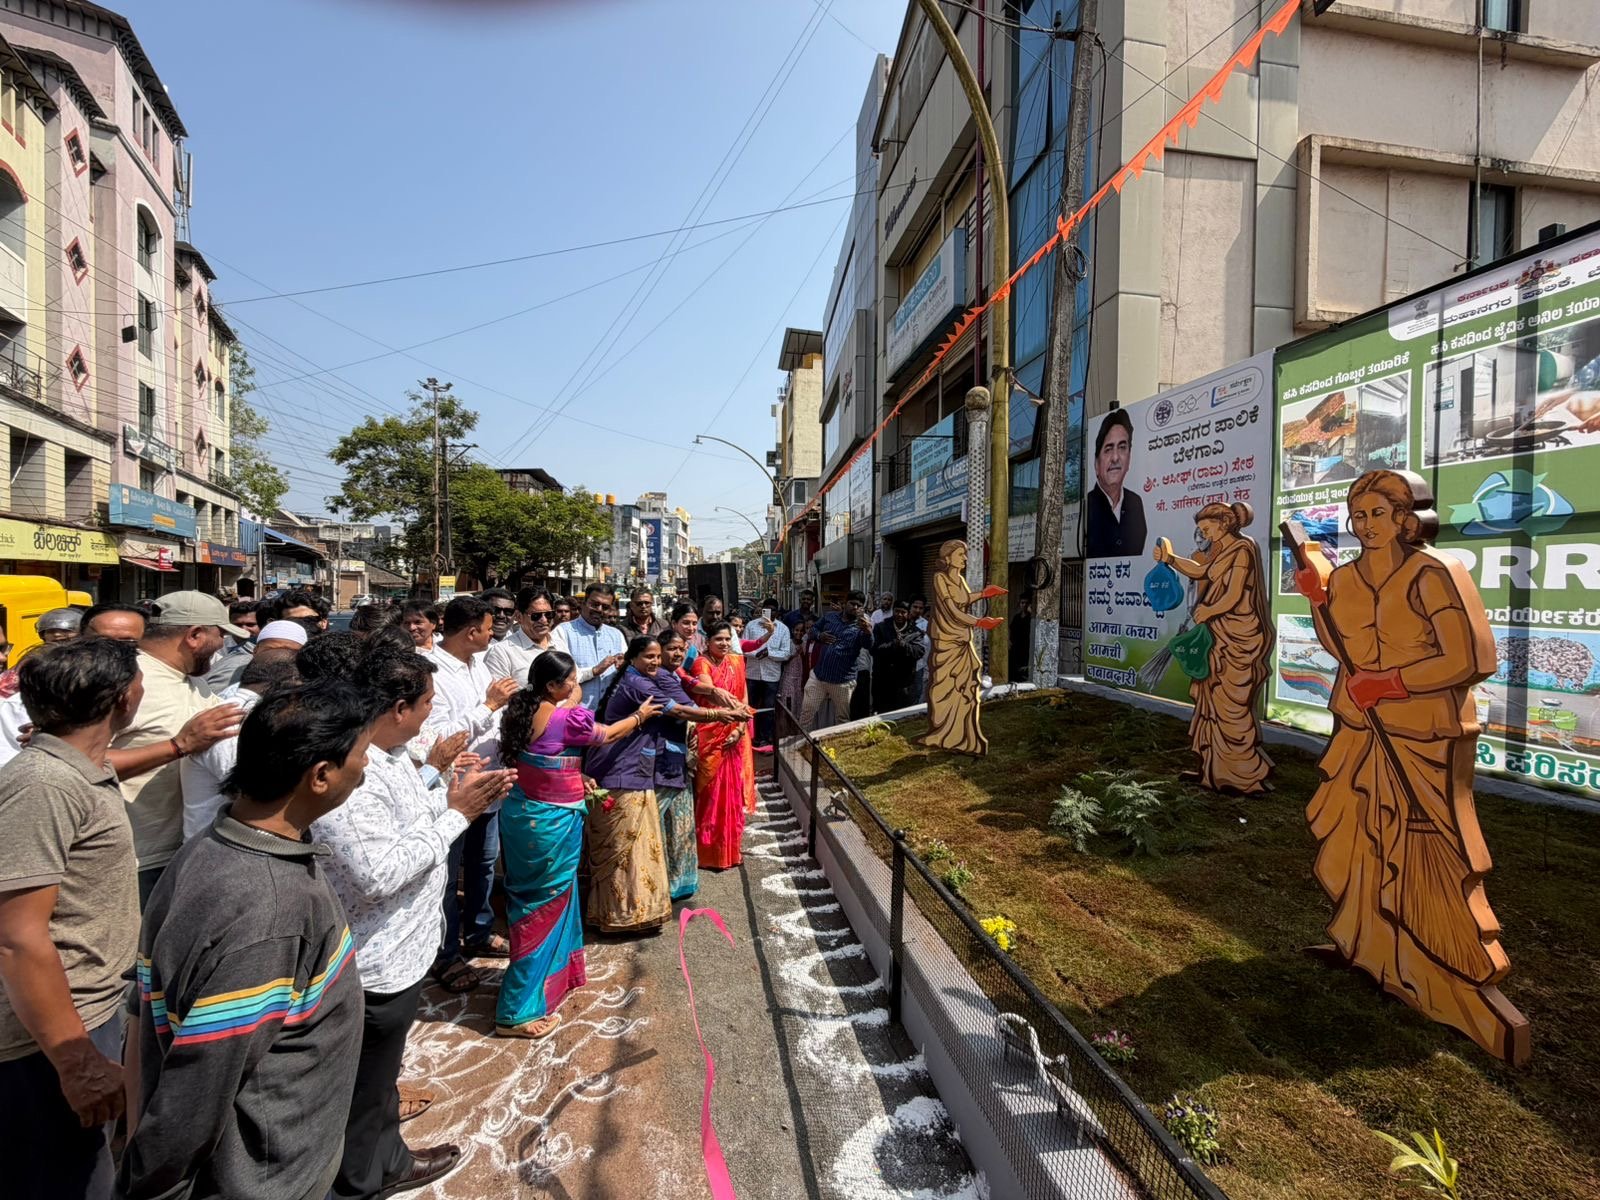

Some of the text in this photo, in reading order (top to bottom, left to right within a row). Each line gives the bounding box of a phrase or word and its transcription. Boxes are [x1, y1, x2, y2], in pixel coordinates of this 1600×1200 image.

[1457, 279, 1510, 303] ಕರ್ನಾಟಕ
[1443, 296, 1512, 325] ಮಹಾನಗರ
[1450, 326, 1492, 350] ಕಸದಿಂದ
[1494, 318, 1524, 340] ಜೈವಿಕ
[1528, 307, 1563, 327] ಅನಿಲ
[1283, 351, 1410, 400] ಹಸಿ ಕಸದಿಂದ ಗೊಬ್ಬರ ತಯಾರಿಕೆ
[1148, 405, 1259, 451] ಮಹಾನಗರ ಪಾಲಿಕೆ
[1173, 439, 1225, 464] ಬೆಳಗಾವಿ
[1089, 561, 1131, 588] ನಮ್ಮ ಕಸ
[1089, 588, 1114, 615] ನಮ್ಮ
[1089, 621, 1158, 640] आमचा कचरा
[1089, 640, 1121, 660] आमची
